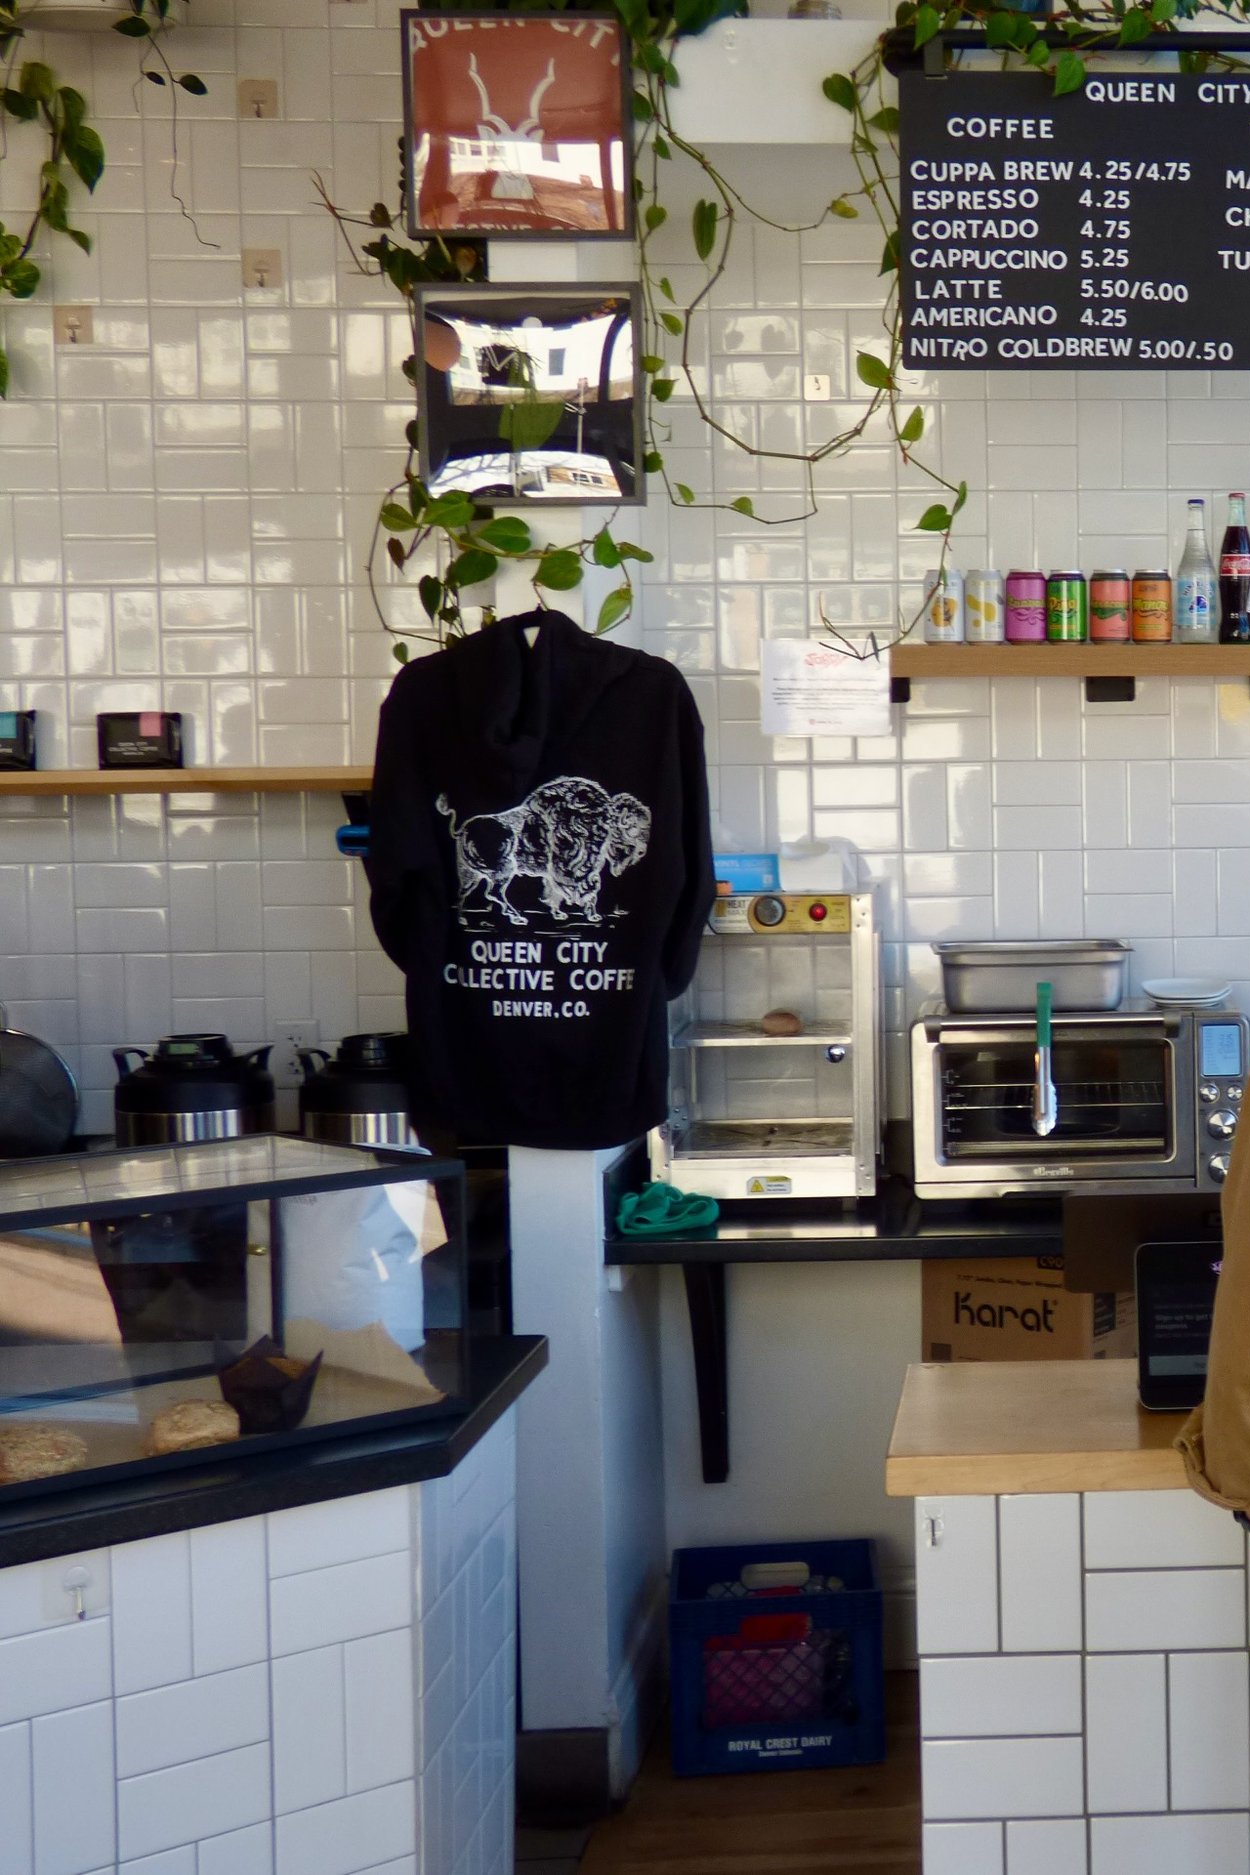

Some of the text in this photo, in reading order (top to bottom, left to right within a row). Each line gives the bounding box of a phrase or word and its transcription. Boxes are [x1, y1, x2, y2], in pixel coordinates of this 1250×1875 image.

[1086, 82, 1174, 102] QUEEN
[948, 118, 1053, 138] COFFEE
[911, 161, 1190, 181] CUPPA BREW 4.25/4.75
[913, 189, 1130, 209] ESPRESSO 4.25
[912, 219, 1130, 240] CORTADO 4.75
[911, 248, 1128, 269] CAPPUCCINO 5.25
[916, 279, 1188, 302] LATTE 5.50/6.00
[911, 306, 1126, 327] AMERICANO 4.25
[911, 338, 1233, 360] NITRO COLDBREW 5.00/.50
[471, 940, 608, 963] QUEEN CITY
[444, 964, 635, 990] CLLECTIVE COFFE
[728, 1736, 832, 1752] ROYAL CREST DAIRY
